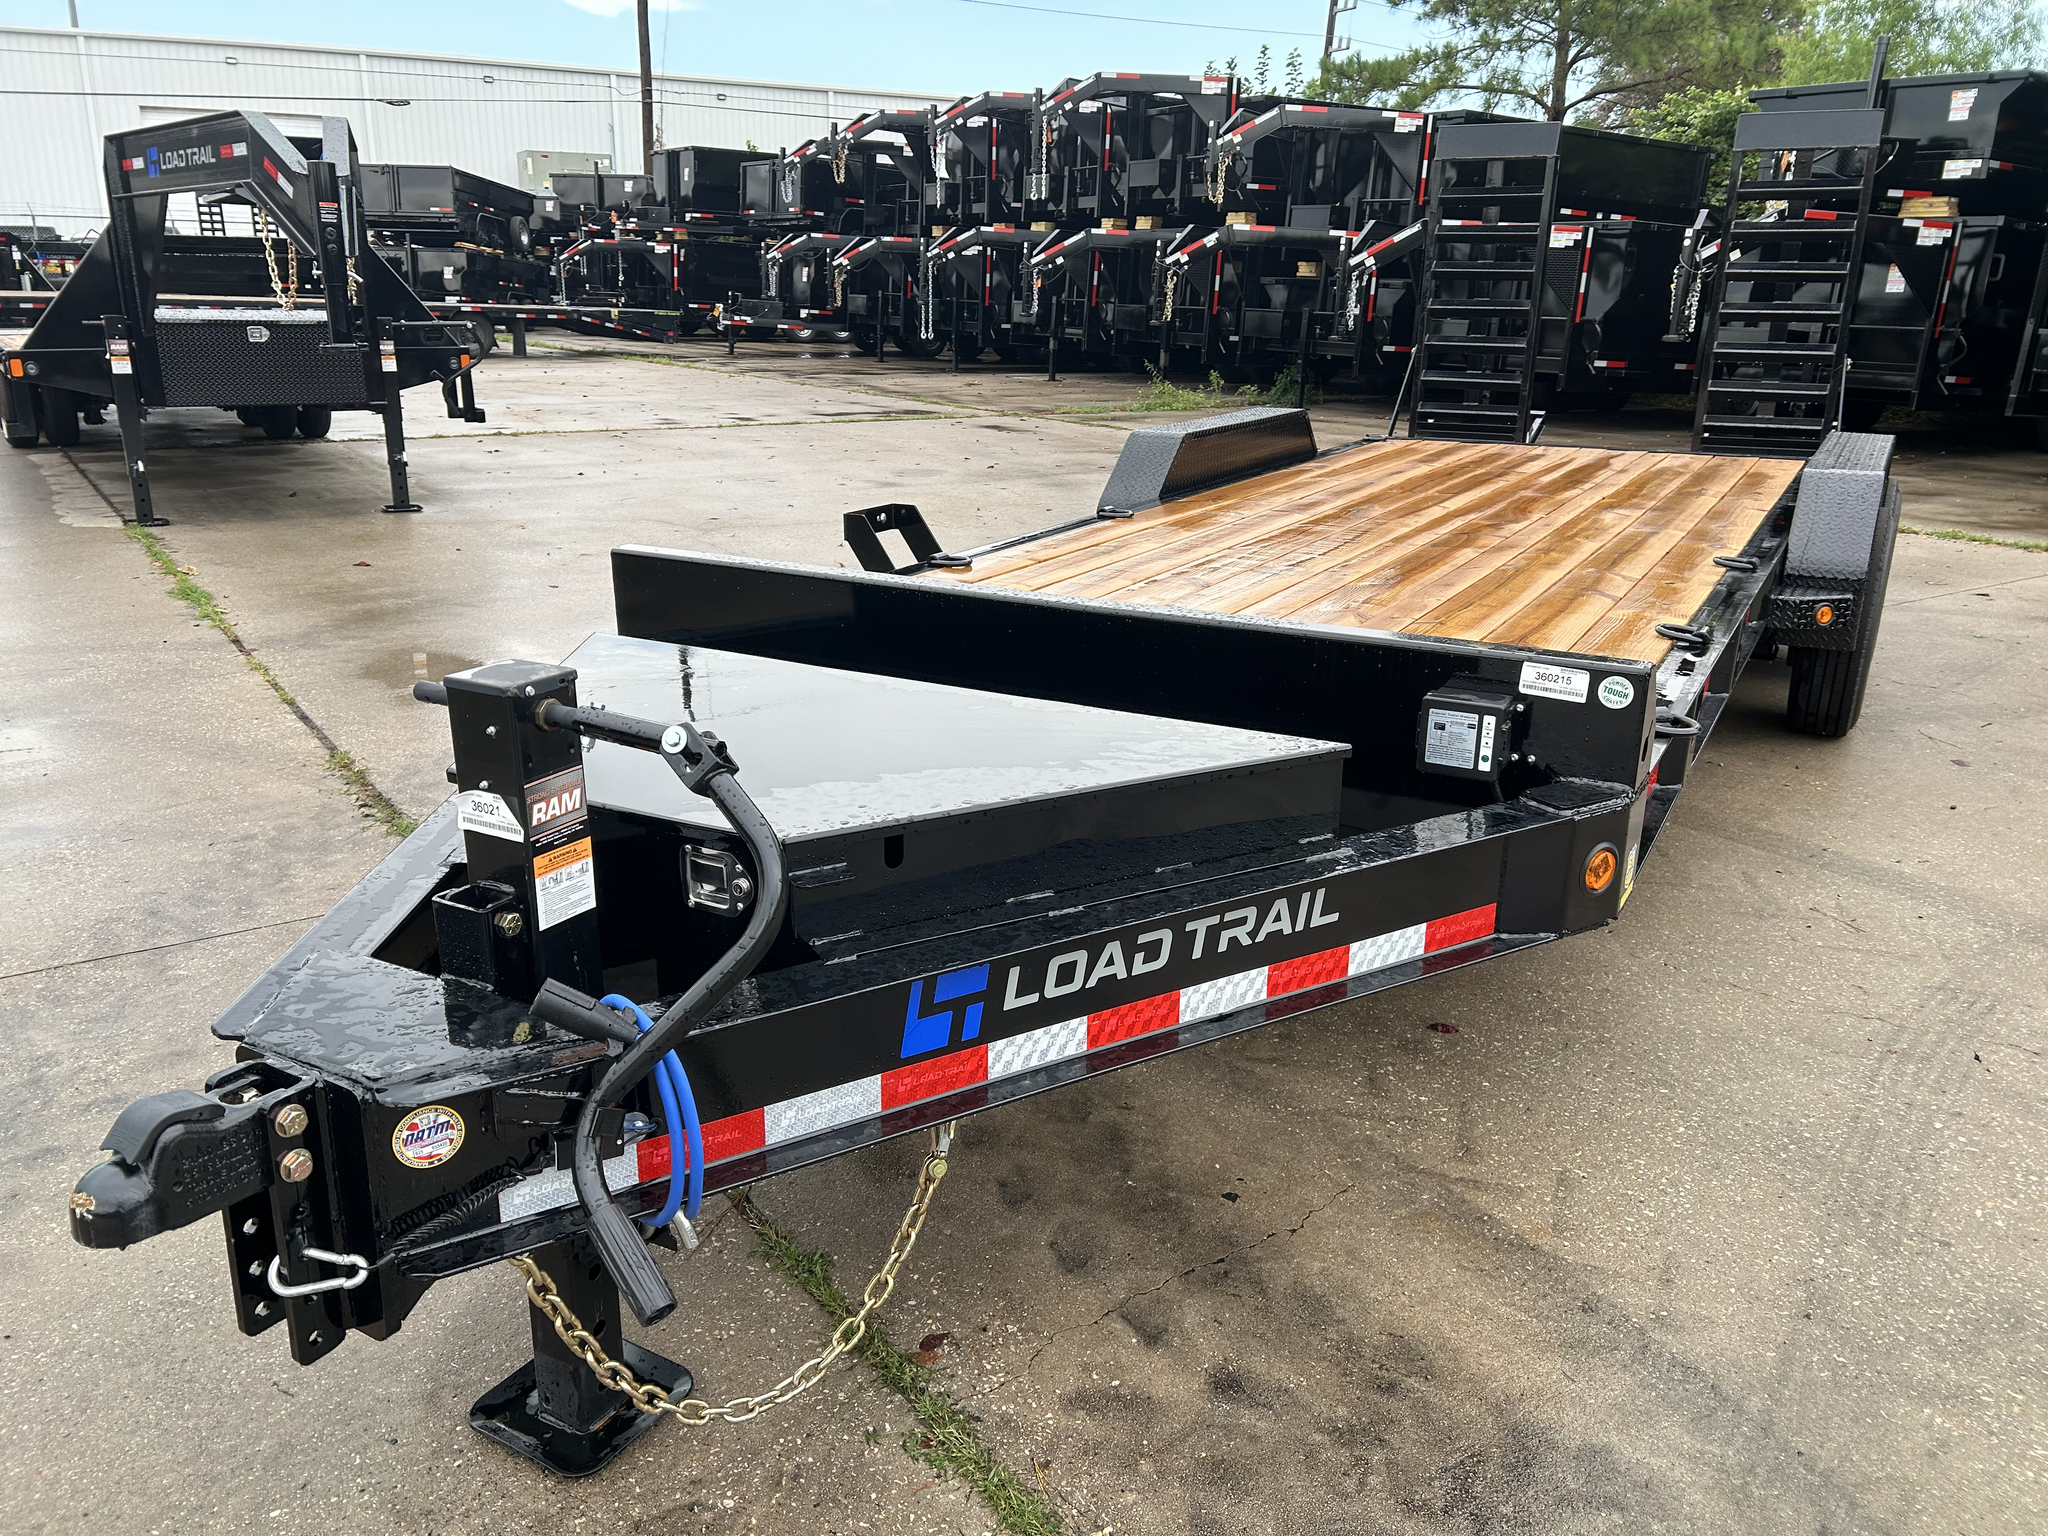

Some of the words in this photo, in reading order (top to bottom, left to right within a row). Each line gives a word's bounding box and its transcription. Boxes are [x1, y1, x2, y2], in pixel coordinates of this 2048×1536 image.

[159, 149, 185, 170] LOAD
[187, 145, 216, 165] TRAIL
[1535, 671, 1572, 686] 360215
[1608, 679, 1629, 691] POWDER
[1602, 695, 1624, 706] COATED
[1603, 685, 1629, 700] TOUGH
[471, 799, 506, 818] 36021
[531, 787, 582, 828] RAM
[1002, 928, 1173, 1011] LOAD
[1185, 888, 1340, 960] TRAIL
[705, 1130, 743, 1147] TRAIL
